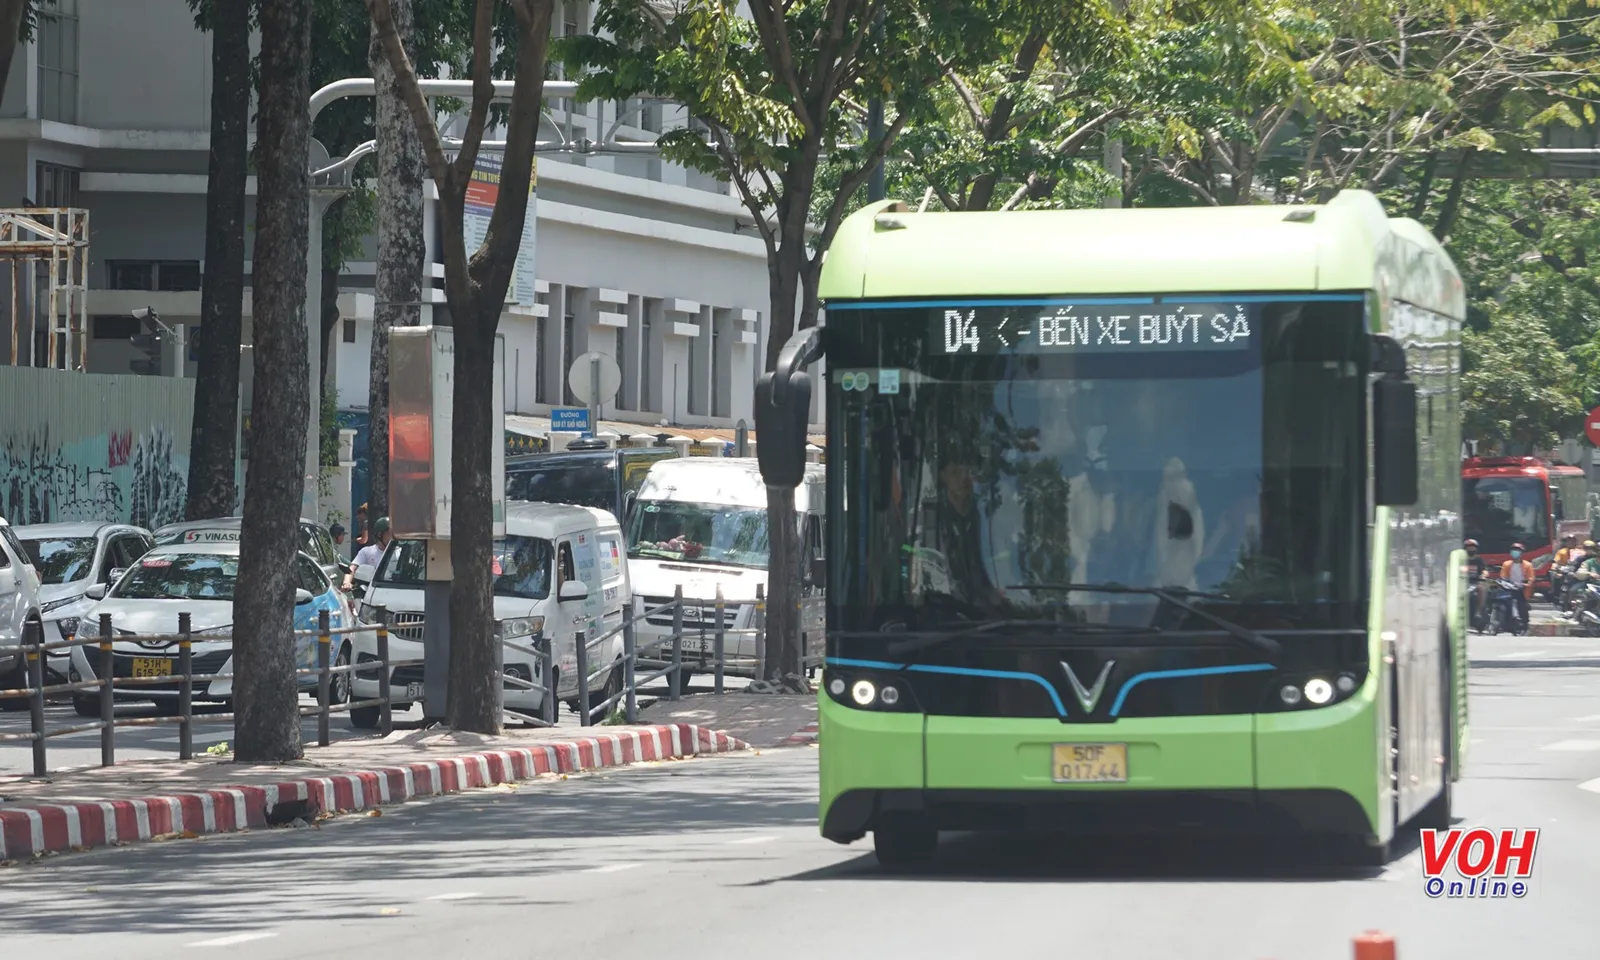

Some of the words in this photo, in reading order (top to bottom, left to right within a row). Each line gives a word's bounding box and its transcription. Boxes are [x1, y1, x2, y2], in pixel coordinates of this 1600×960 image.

[944, 309, 980, 353] D4
[1038, 304, 1090, 347] BẾN
[1096, 314, 1131, 346] XE
[1138, 305, 1203, 346] BUÝT
[143, 659, 161, 668] 51H
[1073, 745, 1105, 762] 50F
